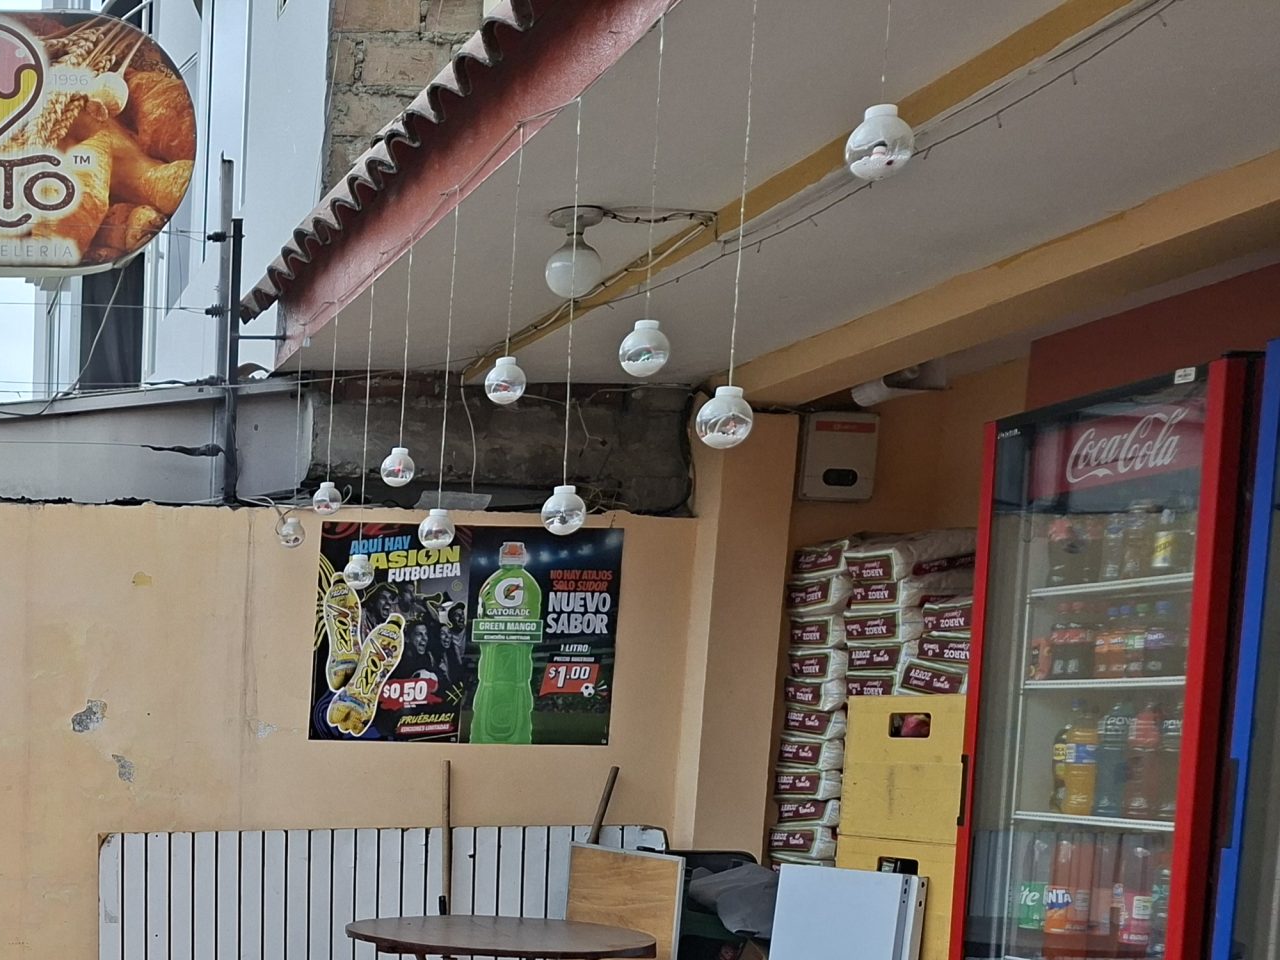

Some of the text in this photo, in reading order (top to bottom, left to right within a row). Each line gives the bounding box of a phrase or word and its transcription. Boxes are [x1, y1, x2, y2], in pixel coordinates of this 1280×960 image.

[53, 73, 89, 87] 1996
[1066, 407, 1188, 483] Coca-Cola
[350, 535, 411, 555] AQUÍ HAY
[387, 562, 461, 582] FUTBOLERA
[550, 570, 613, 581] NO HAY ATAJOS
[494, 577, 524, 608] G
[552, 580, 609, 592] SOLO SUDOR
[548, 591, 611, 613] NUEVO
[479, 622, 537, 631] GREEN MANGO
[545, 613, 609, 634] SABOR
[940, 617, 965, 627] ARROZ
[565, 643, 589, 653] LITRO
[548, 665, 591, 688] $1.00
[909, 668, 933, 681] ARROZ
[1048, 888, 1072, 903] NTA
